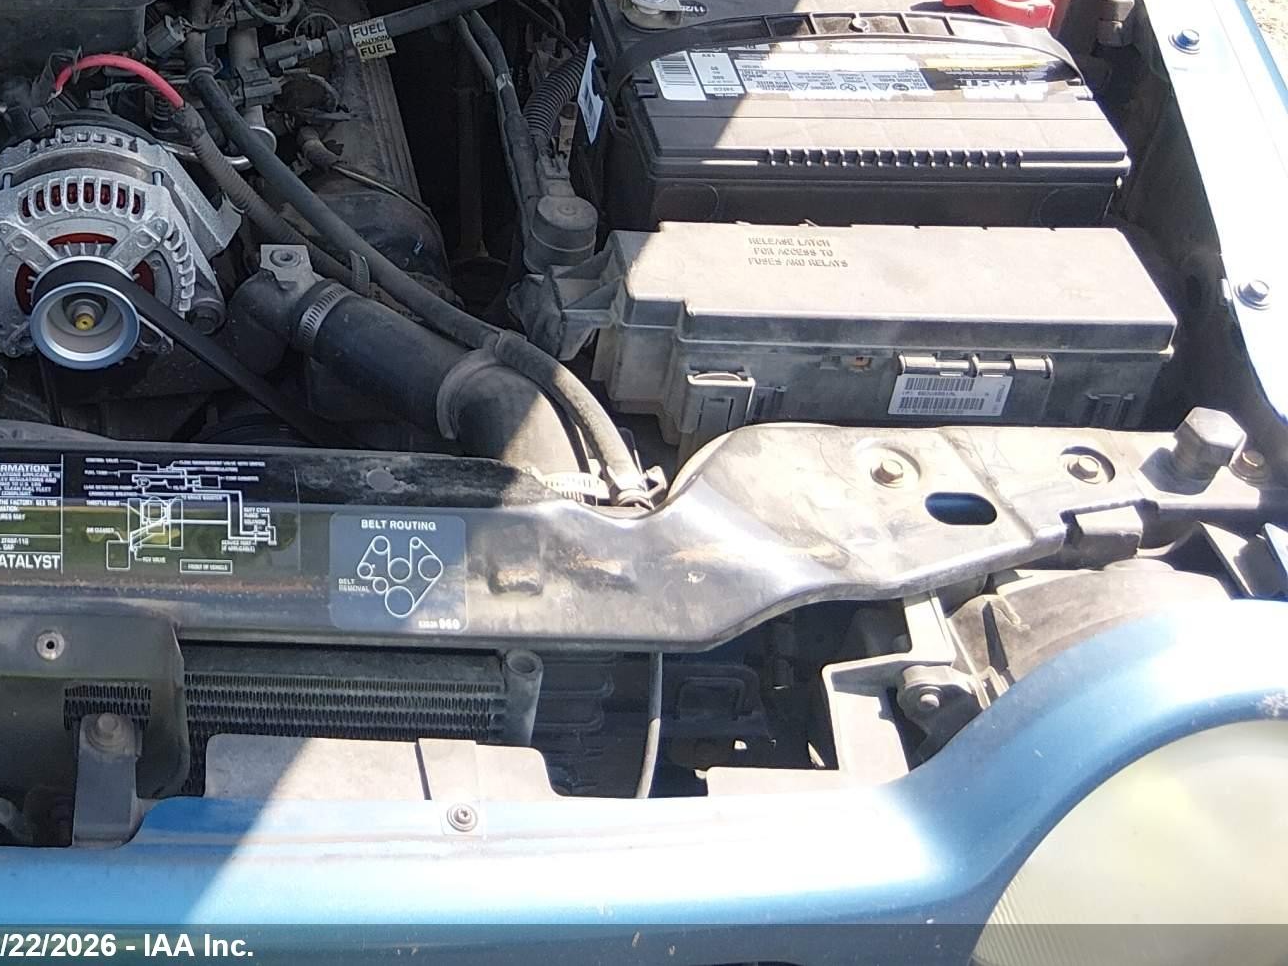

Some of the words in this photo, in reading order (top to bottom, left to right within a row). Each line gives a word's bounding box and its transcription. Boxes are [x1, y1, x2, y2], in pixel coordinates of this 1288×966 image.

[352, 22, 384, 39] FUEL
[360, 43, 393, 57] FUEL
[748, 237, 794, 246] RELEASE
[797, 238, 831, 247] LATCH
[753, 247, 774, 256] FOR
[778, 248, 817, 257] ACCESS
[819, 249, 833, 257] TO
[748, 257, 782, 266] FUSES
[808, 259, 849, 268] RELAYS
[361, 519, 388, 529] BELT
[389, 520, 437, 531] ROUTING
[338, 584, 371, 593] REMOVAL
